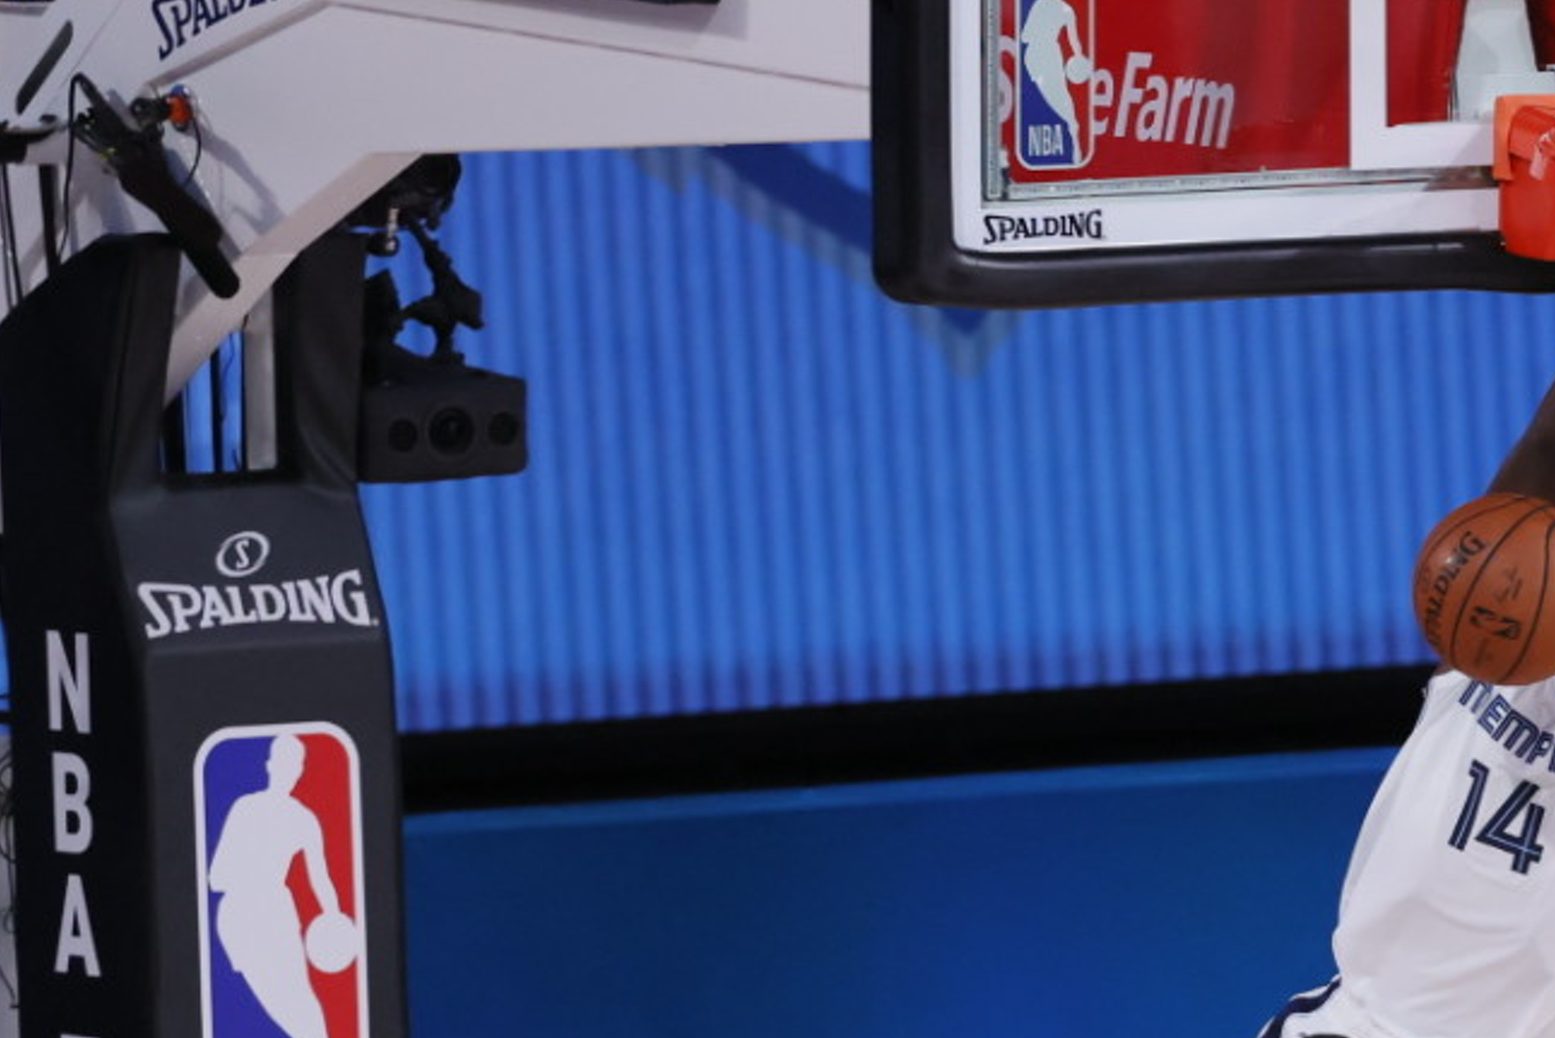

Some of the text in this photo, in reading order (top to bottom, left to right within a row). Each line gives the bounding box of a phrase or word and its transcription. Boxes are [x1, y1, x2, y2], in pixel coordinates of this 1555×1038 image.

[1028, 123, 1065, 157] NBA
[983, 209, 1103, 245] SPALDING
[138, 569, 372, 639] SPALDING
[46, 630, 101, 978] NBA
[1448, 758, 1545, 875] 14
